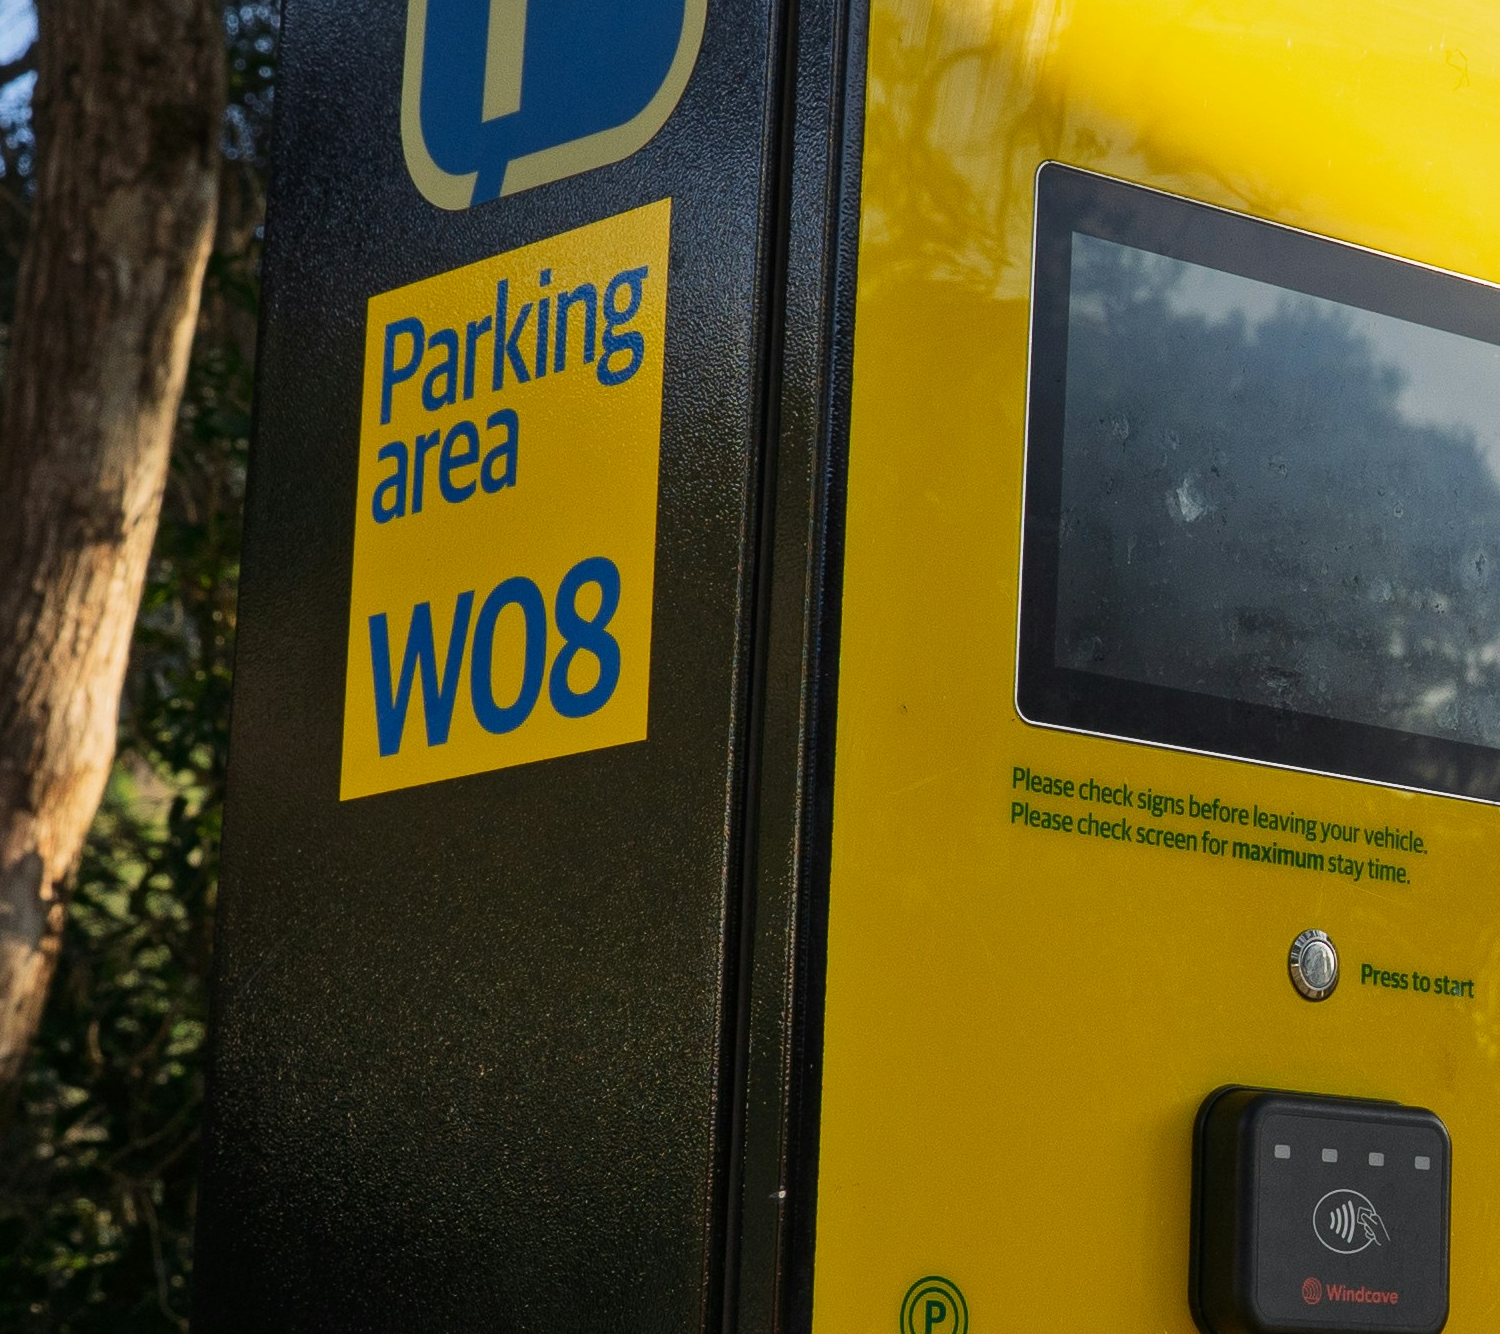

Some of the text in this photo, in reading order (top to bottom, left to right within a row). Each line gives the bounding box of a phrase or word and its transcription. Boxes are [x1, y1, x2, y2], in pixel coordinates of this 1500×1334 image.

[379, 264, 649, 427] Parking
[370, 407, 519, 525] area
[367, 555, 621, 758] W08
[1011, 801, 1411, 885] Please check screen for maximum stay time.
[1012, 766, 1428, 855] Please check signs before leaving your vehicle.
[1360, 962, 1475, 999] Press to start
[924, 1299, 947, 1334] P
[1325, 1283, 1399, 1305] Windcave
